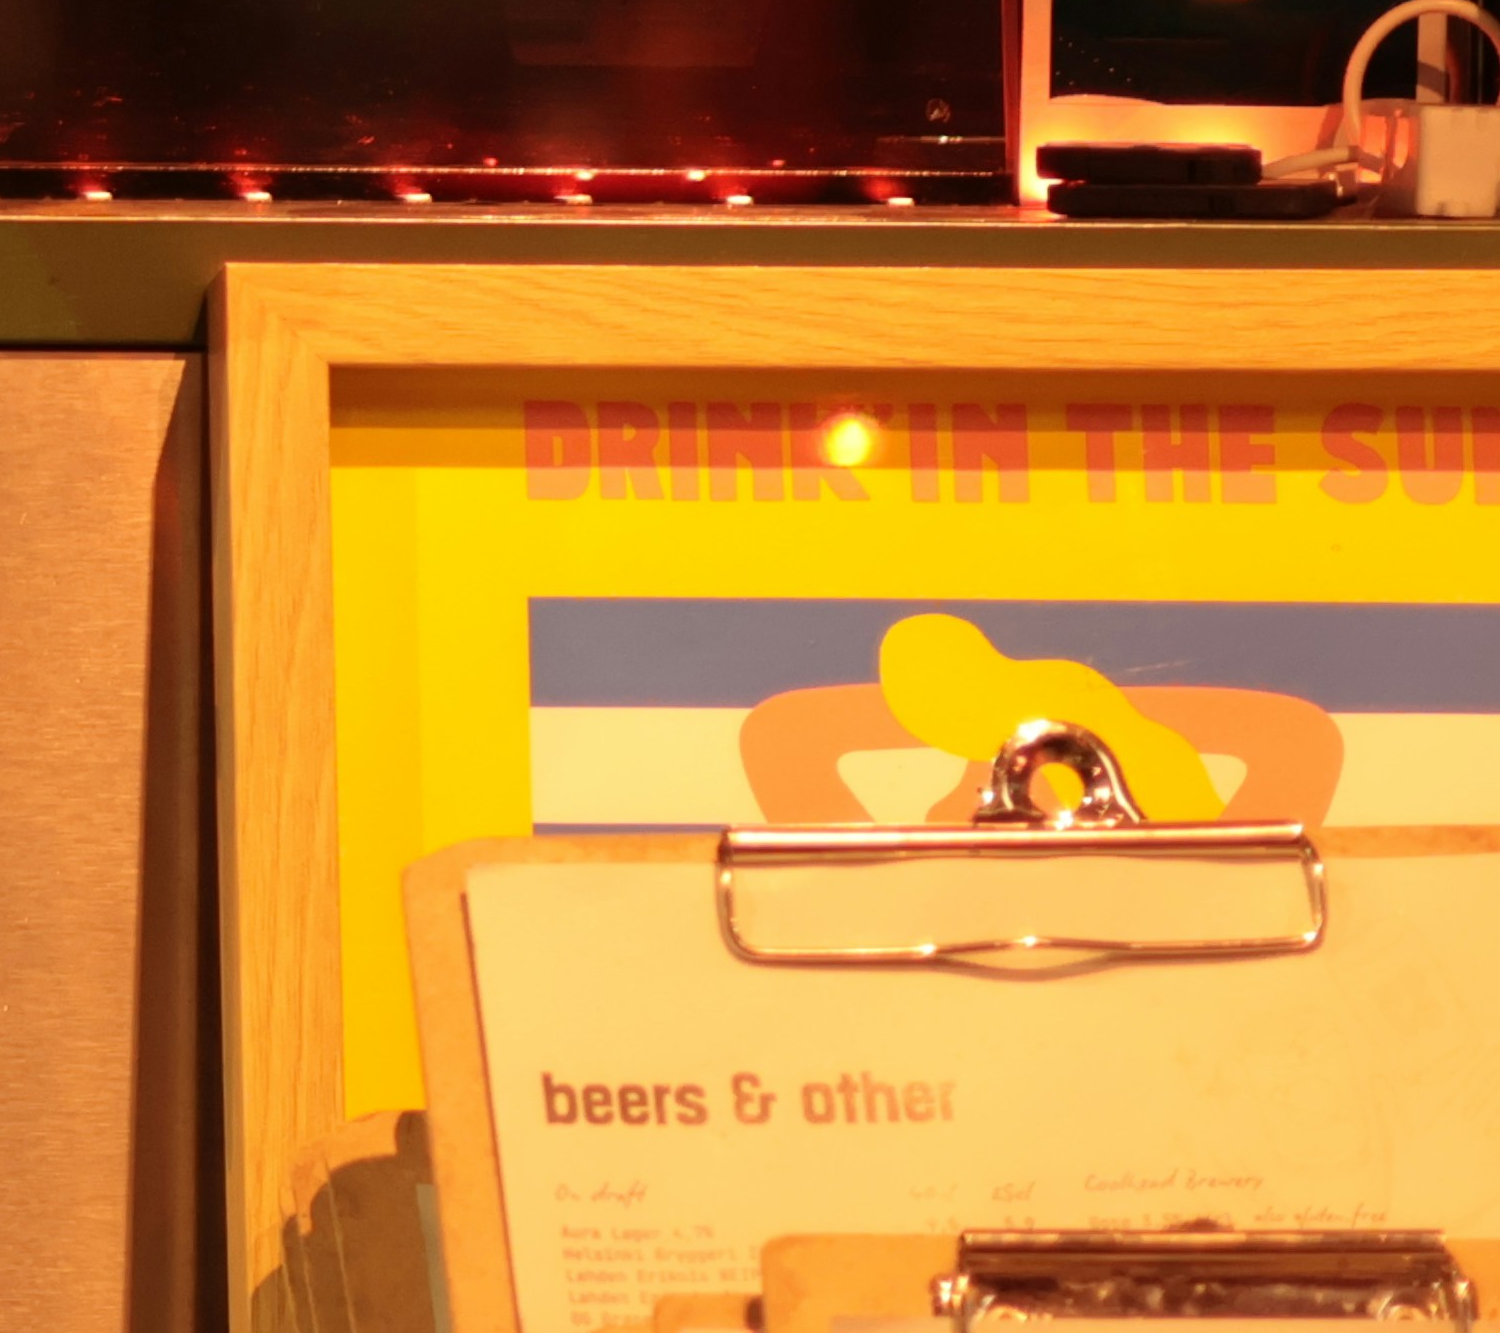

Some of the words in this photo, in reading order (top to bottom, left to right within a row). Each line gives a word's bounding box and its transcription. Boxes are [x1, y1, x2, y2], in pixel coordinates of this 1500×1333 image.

[523, 399, 893, 504] DRINK
[910, 401, 1030, 505] IN
[1065, 402, 1278, 506] THE
[541, 1069, 710, 1127] beers
[730, 1070, 778, 1127] &
[801, 1069, 956, 1127] other
